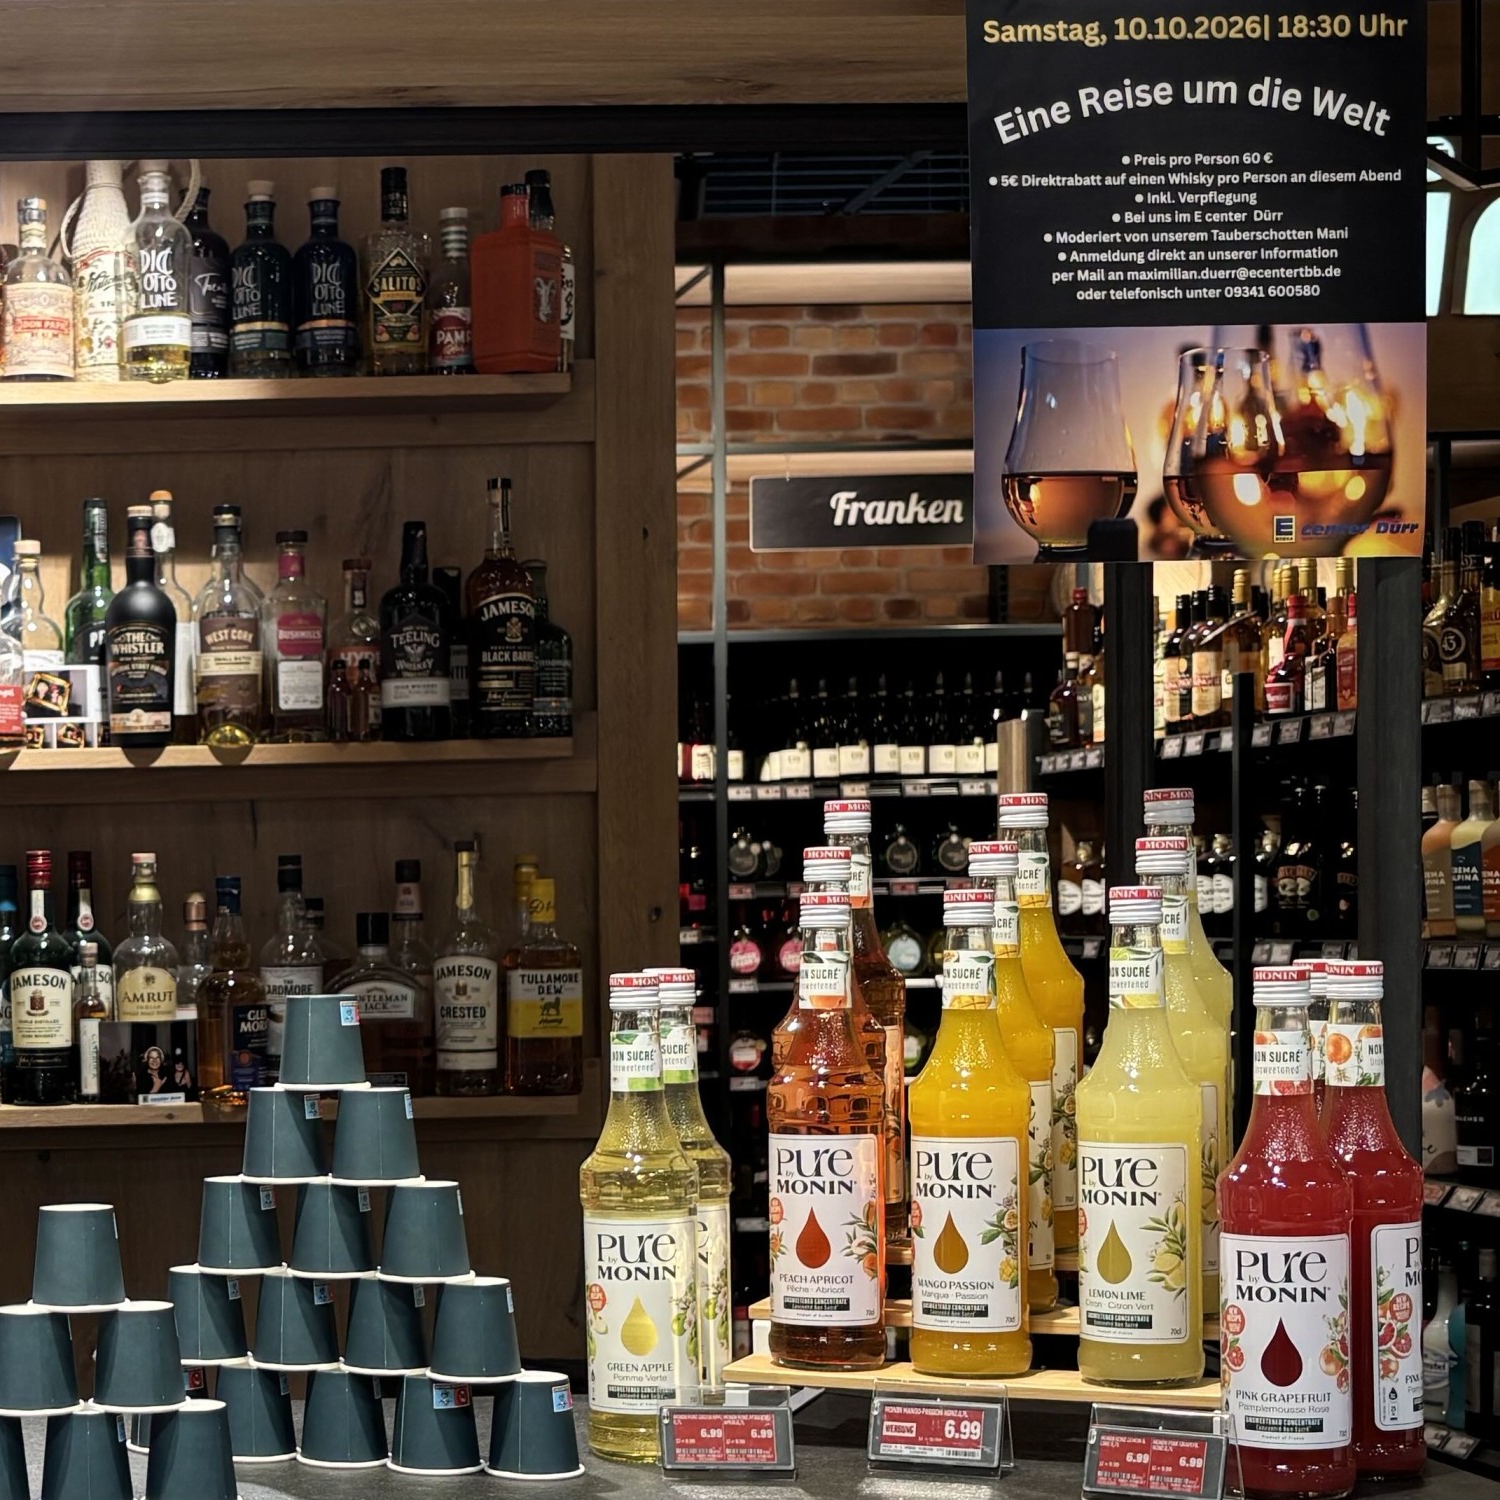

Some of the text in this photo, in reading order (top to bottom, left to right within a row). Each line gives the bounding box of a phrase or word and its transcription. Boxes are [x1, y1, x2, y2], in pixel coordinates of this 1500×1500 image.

[983, 19, 1107, 46] Samstag,
[1278, 15, 1350, 38] 18:30
[1359, 14, 1408, 37] Uhr
[993, 77, 1391, 145] Eine Reise um die Welt
[1134, 152, 1273, 168] Preis pro Person 60 €
[1001, 168, 1402, 187] 5€ Direktrabatt auf einen Whisky pro Person an diesem Abend
[1147, 190, 1257, 207] Inkl. Verpflegung
[1124, 209, 1283, 224] Bei uns im E center Dürr
[1056, 227, 1348, 244] Moderiert von unserem Tauberschotten Mani
[1070, 246, 1338, 264] Anmeldung direkt an unserer Information
[1052, 265, 1341, 284] per Mail an maximilian.duerr@ecentertbb.de
[373, 276, 422, 292] SALITOS
[1076, 284, 1320, 301] oder telefonisch unter 09341 600580
[830, 491, 964, 527] Franken
[126, 632, 145, 643] THE
[205, 629, 254, 645] WEST CORK
[278, 629, 322, 640] BUSHMILLS
[390, 631, 440, 648] TEELING
[112, 642, 165, 655] WHISTLER
[481, 651, 510, 663] BLACK
[395, 659, 434, 671] WHISKEY
[435, 965, 492, 981] JAMESON
[519, 973, 579, 986] TULLAMORE
[12, 974, 67, 991] JAMESON
[266, 984, 314, 995] ARDMORE
[123, 990, 174, 1003] AMRUT
[440, 1005, 487, 1020] CRESTED
[777, 1148, 853, 1178] Pure
[916, 1151, 993, 1181] Pure
[1082, 1156, 1158, 1188] Pure
[777, 1180, 854, 1195] MONIN
[916, 1183, 992, 1199] MONIN
[1081, 1189, 1157, 1206] MONIN
[597, 1233, 676, 1264] Pure
[597, 1265, 676, 1281] MONIN
[1236, 1250, 1327, 1284] Pure
[780, 1274, 854, 1284] PEACH APRICOT
[918, 1278, 994, 1290] MANGO PASSION
[787, 1285, 809, 1293] Pêche
[922, 1290, 988, 1300] Mangue Passion
[1089, 1288, 1145, 1301] LEMON LIME
[1236, 1285, 1327, 1303] MONIN
[1108, 1300, 1154, 1310] Citron Vert
[607, 1362, 673, 1372] GREEN APPLE
[613, 1374, 667, 1382] Pomme Verte
[1236, 1390, 1331, 1403] PINK GRAPEFRUIT
[1238, 1401, 1330, 1413] Pamplemousse Rose
[701, 1428, 722, 1438] 6.99
[751, 1429, 773, 1438] 6.99
[944, 1419, 981, 1440] 6.99
[1126, 1452, 1149, 1463] 6.99
[1179, 1457, 1203, 1467] 6.99
